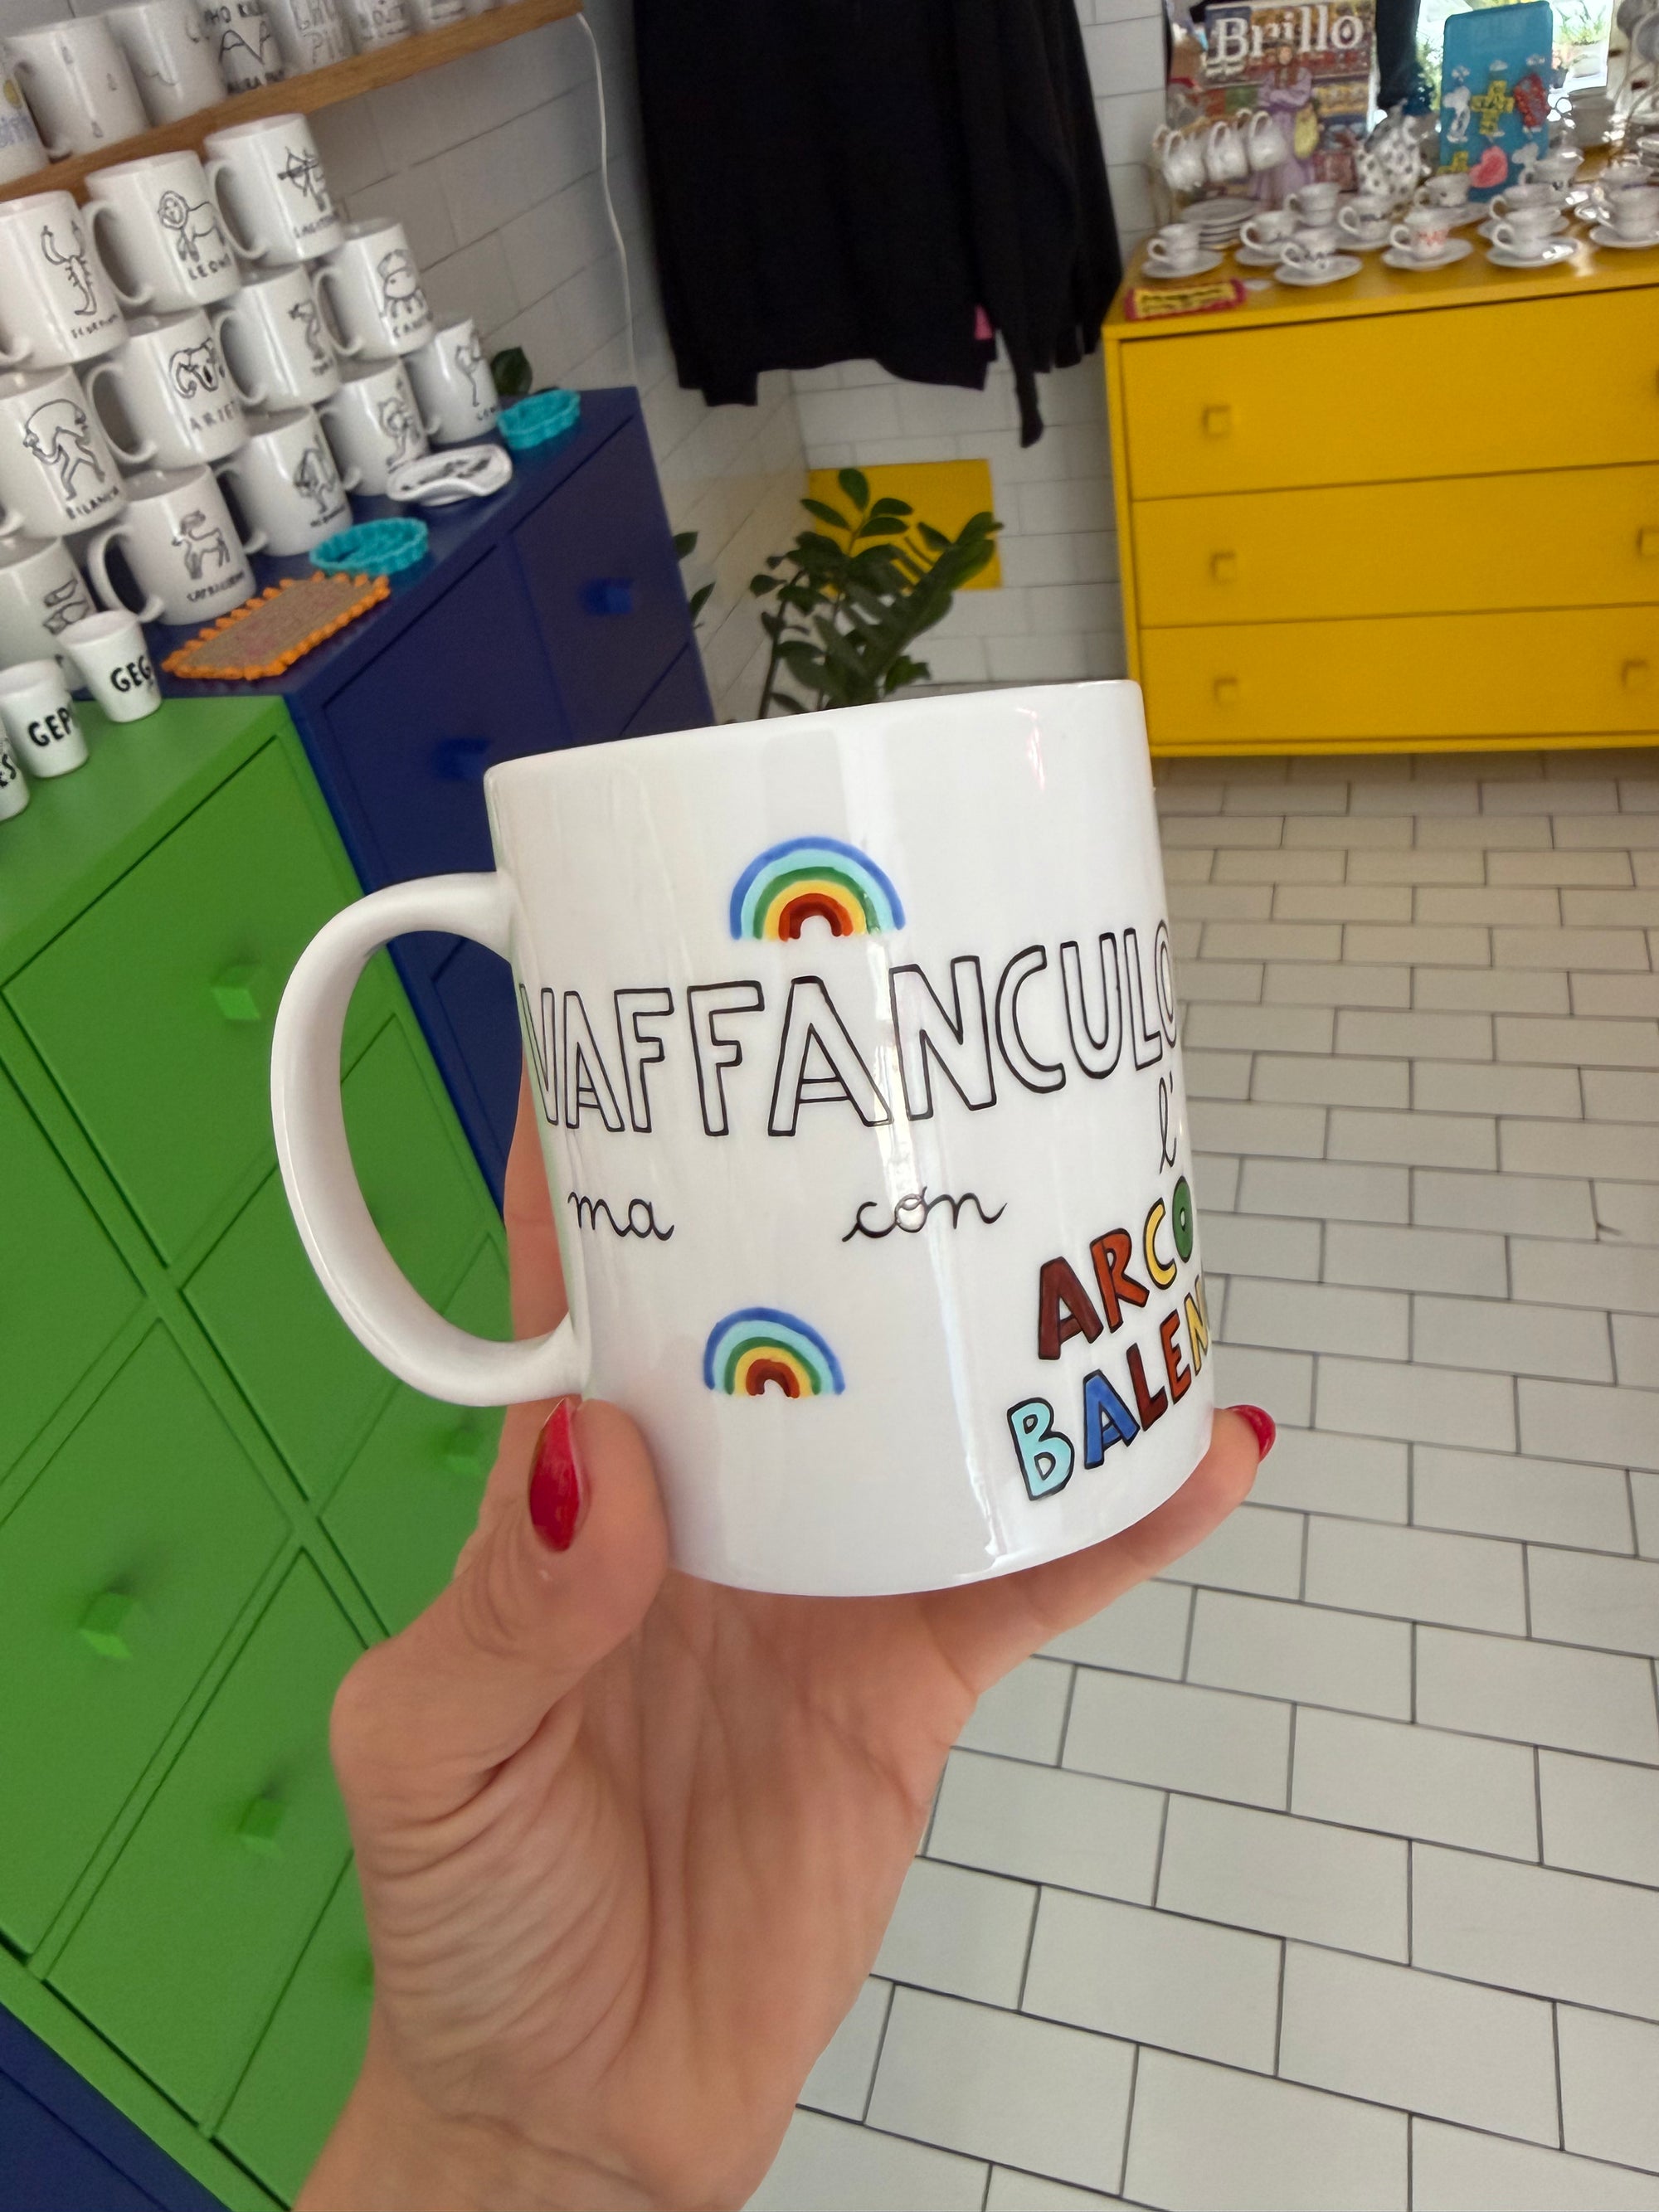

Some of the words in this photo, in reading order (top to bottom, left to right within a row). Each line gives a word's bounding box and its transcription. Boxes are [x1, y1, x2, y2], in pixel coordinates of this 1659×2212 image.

[1207, 4, 1363, 68] Brillo
[519, 918, 1177, 1138] VAFFANCULO
[568, 1192, 674, 1241] ma
[841, 1185, 1008, 1242] con
[1038, 1175, 1194, 1360] ARCO
